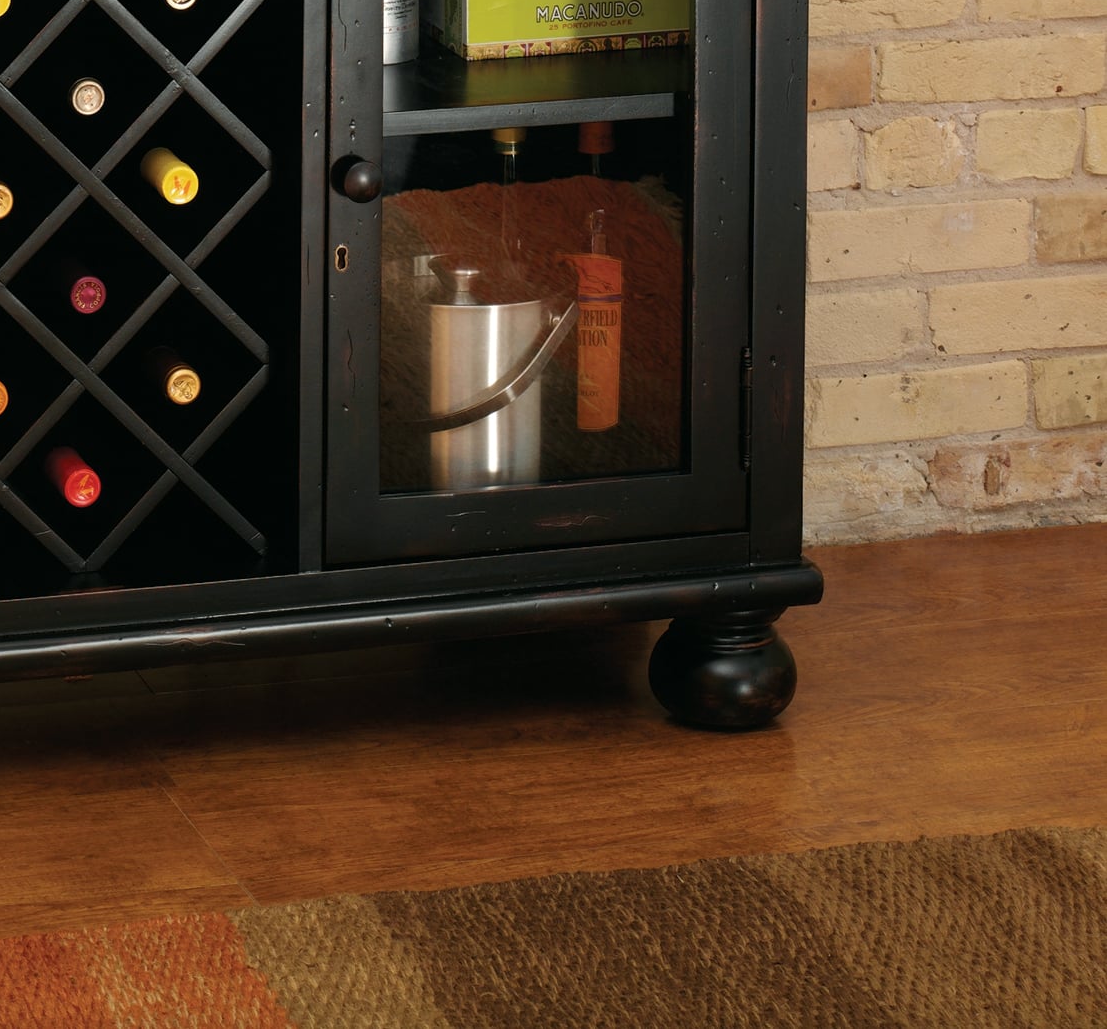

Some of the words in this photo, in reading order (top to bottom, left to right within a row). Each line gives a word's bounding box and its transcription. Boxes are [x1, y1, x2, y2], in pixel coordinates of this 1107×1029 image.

[536, 0, 643, 23] MACANUDO
[562, 21, 608, 29] PORTOFINO
[580, 329, 608, 347] TION
